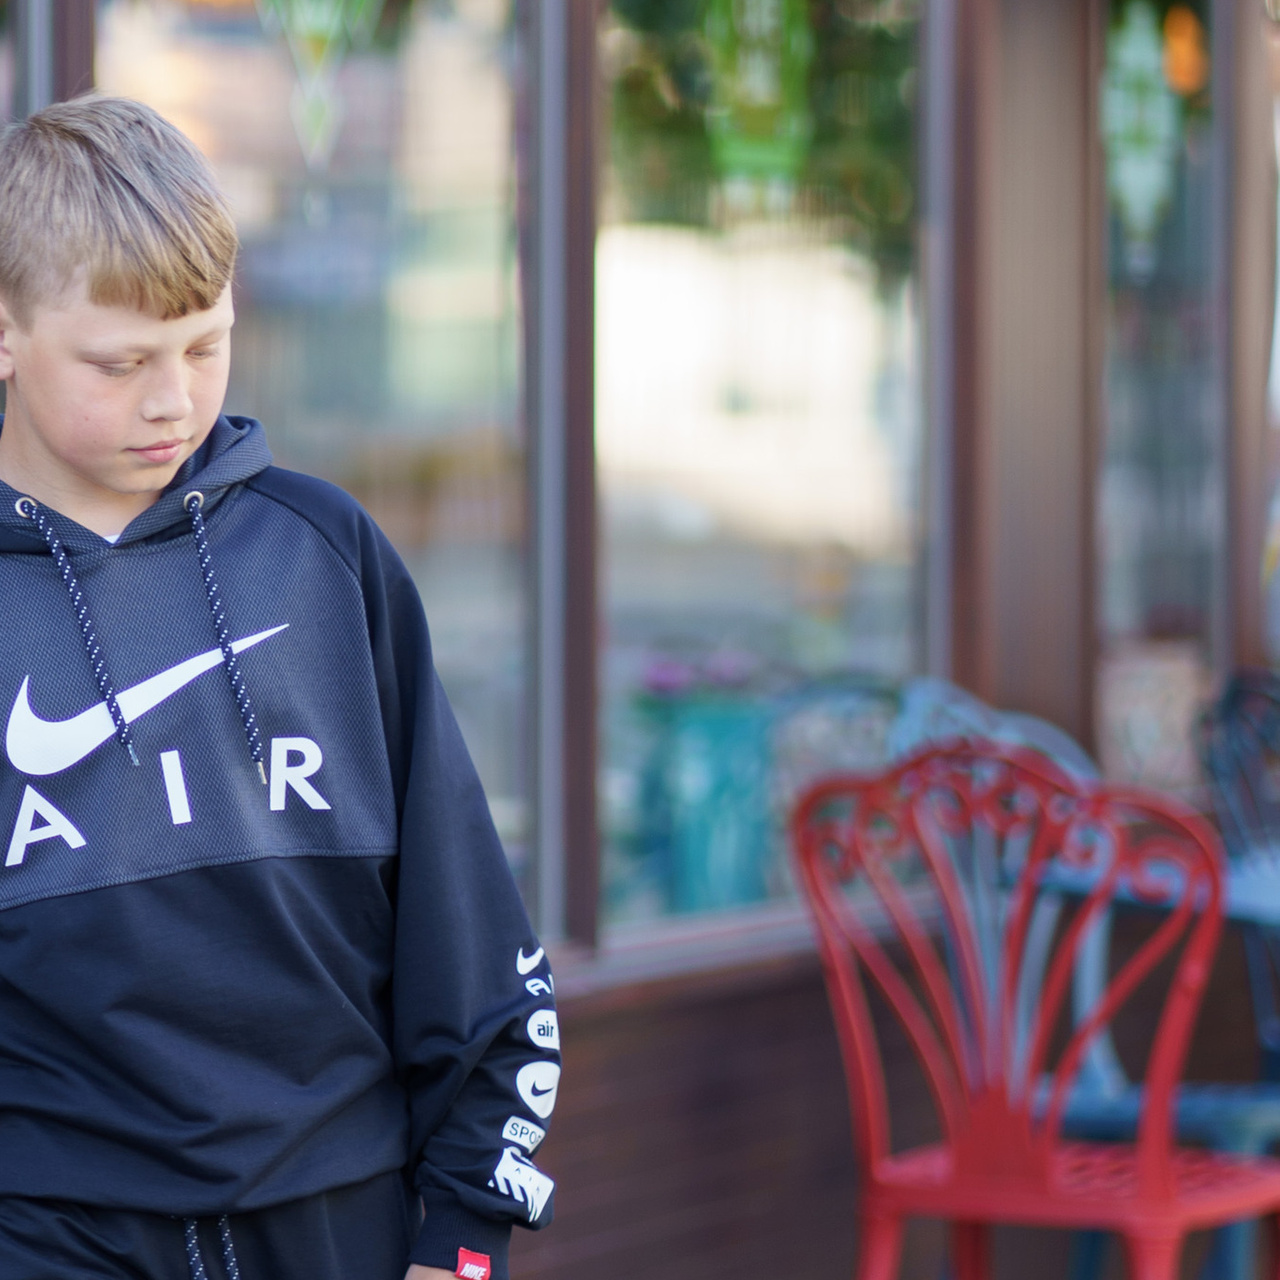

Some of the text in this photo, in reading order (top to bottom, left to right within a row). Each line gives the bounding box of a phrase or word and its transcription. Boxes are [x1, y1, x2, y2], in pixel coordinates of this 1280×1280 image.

[5, 737, 332, 867] AIR
[537, 1021, 554, 1037] air
[460, 1262, 487, 1280] NIKE
